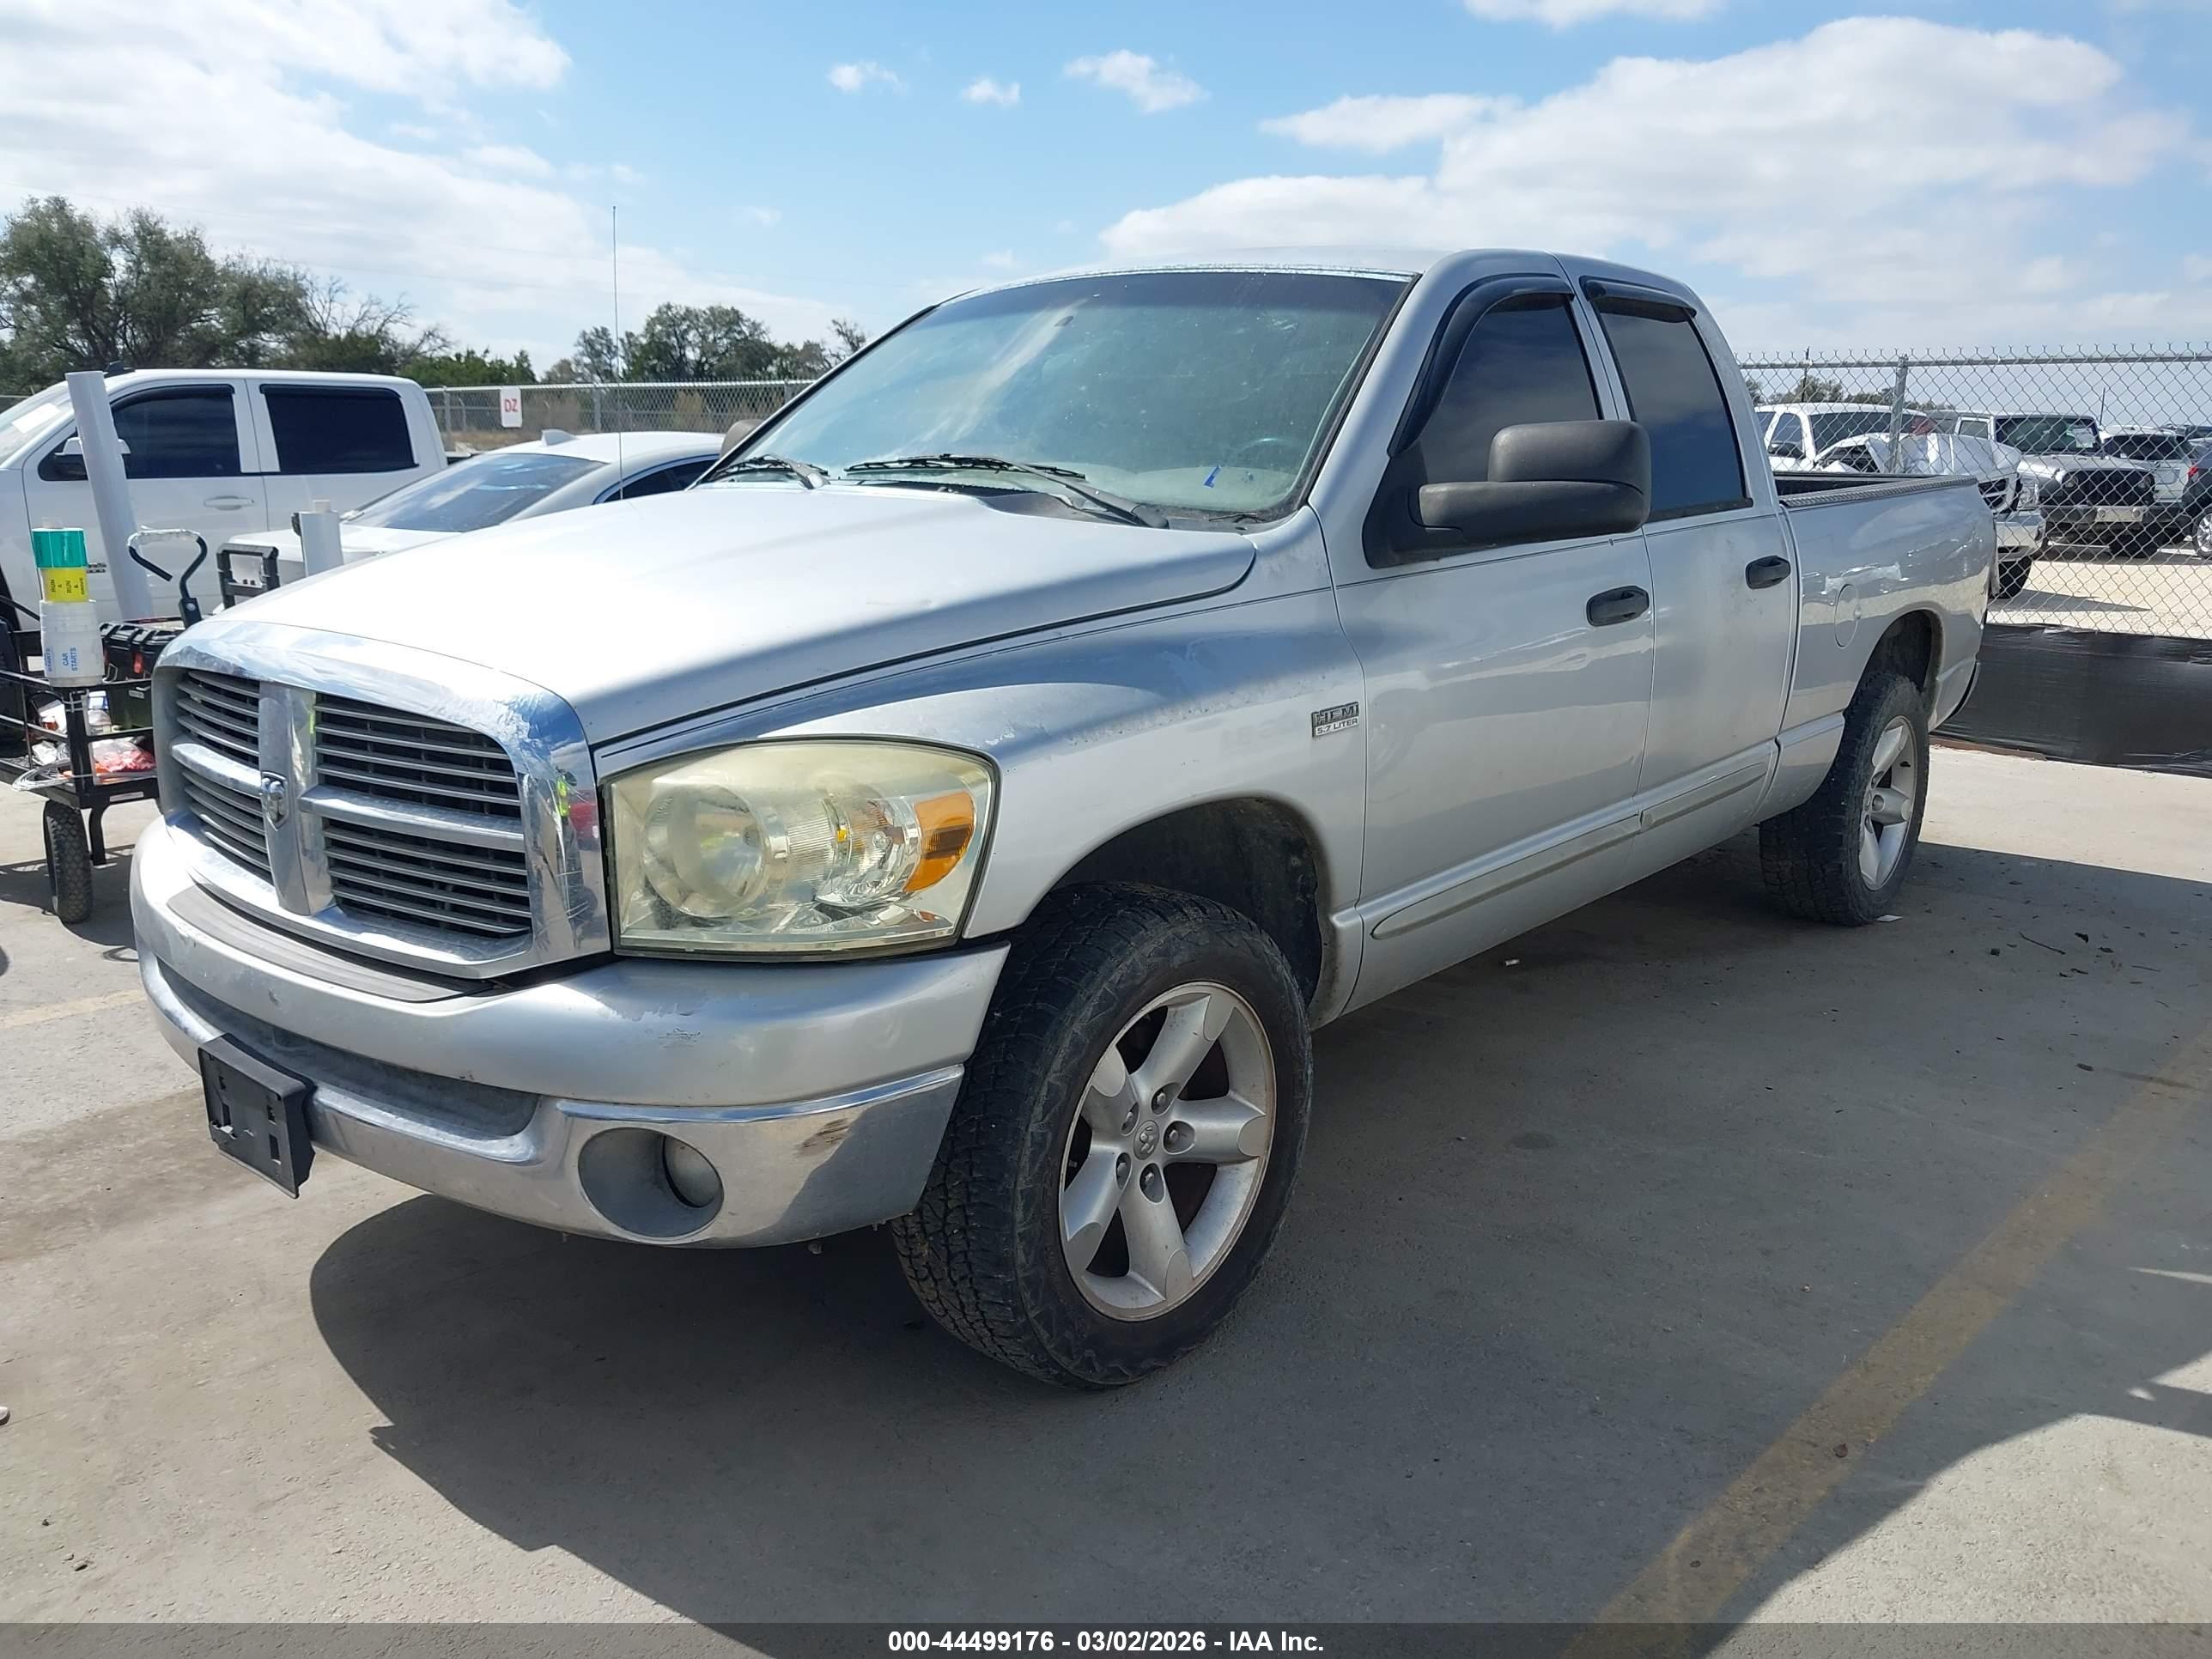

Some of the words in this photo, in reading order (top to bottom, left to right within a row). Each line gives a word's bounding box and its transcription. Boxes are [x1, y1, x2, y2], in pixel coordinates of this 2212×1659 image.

[1315, 703, 1358, 726] HEMI
[1317, 725, 1331, 735] 5.7
[1334, 718, 1358, 730] LITER
